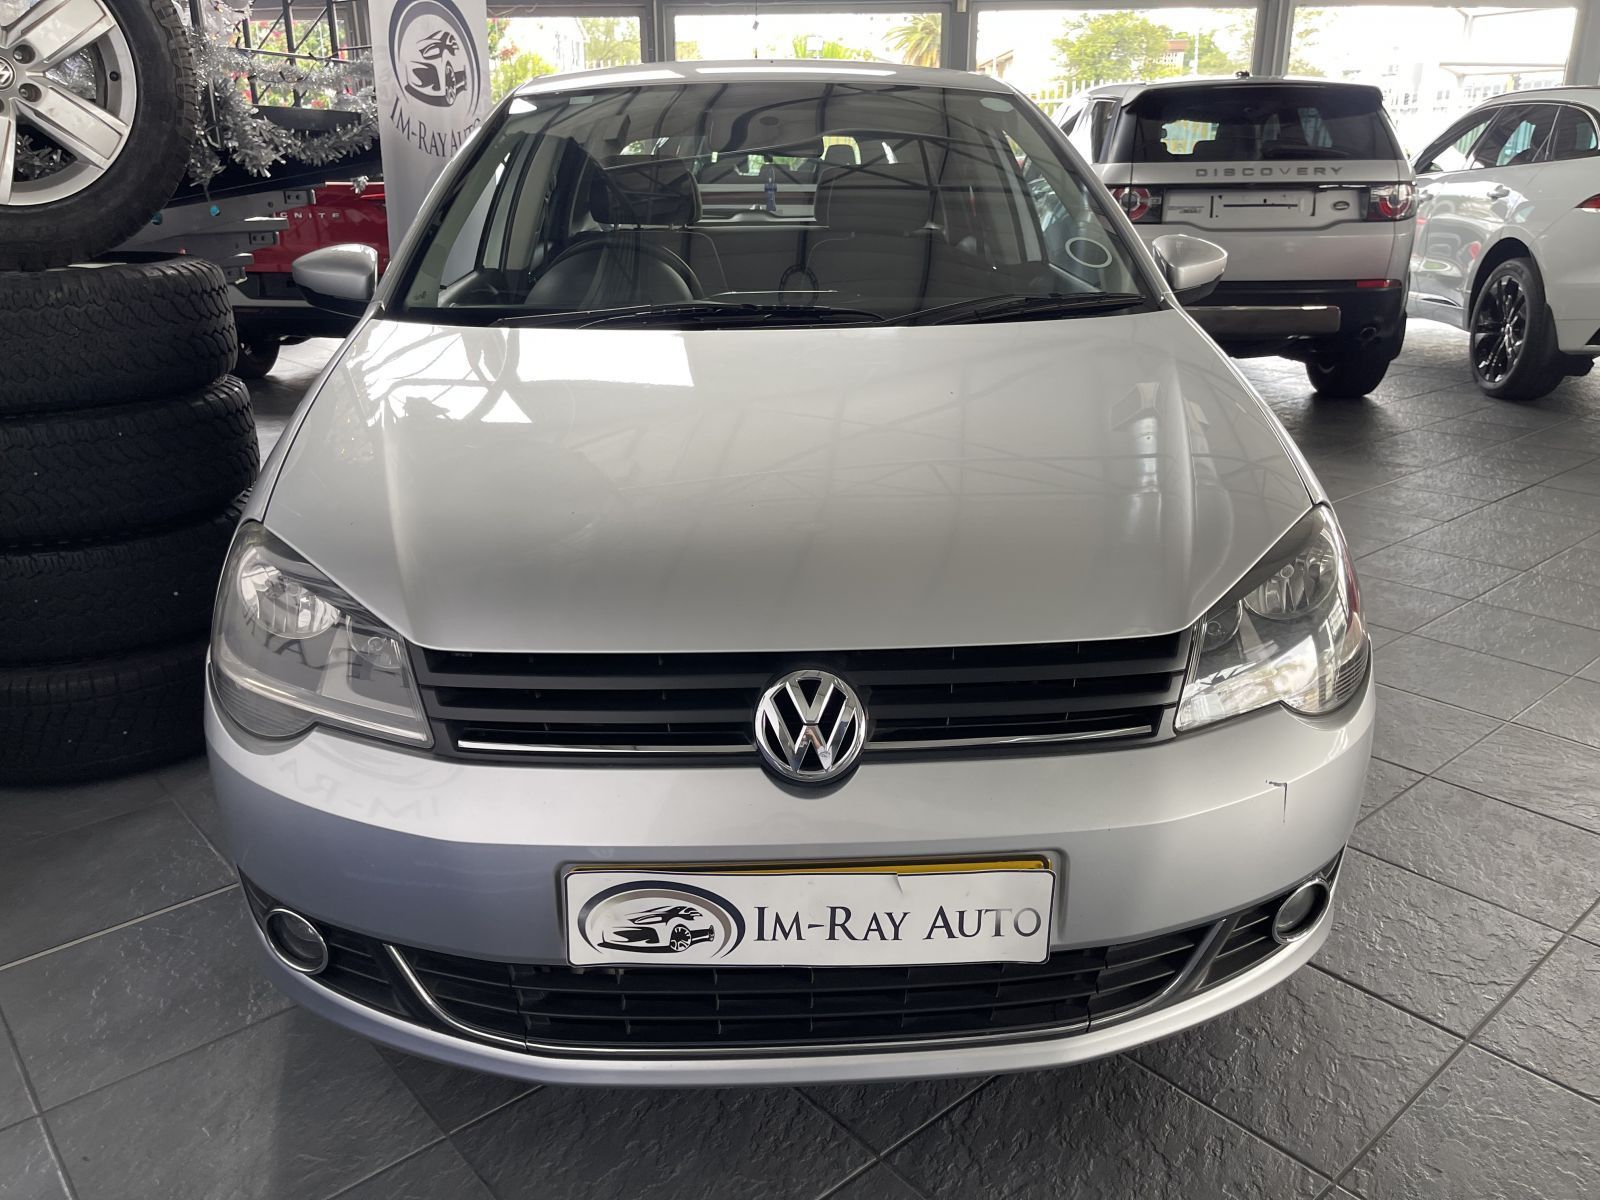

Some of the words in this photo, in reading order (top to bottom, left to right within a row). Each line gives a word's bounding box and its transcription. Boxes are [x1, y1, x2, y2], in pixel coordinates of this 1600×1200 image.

[390, 96, 447, 157] IM-RAY
[1195, 167, 1343, 177] DISCOVERY
[753, 906, 910, 941] IM-RAY
[924, 906, 1042, 940] AUTO
